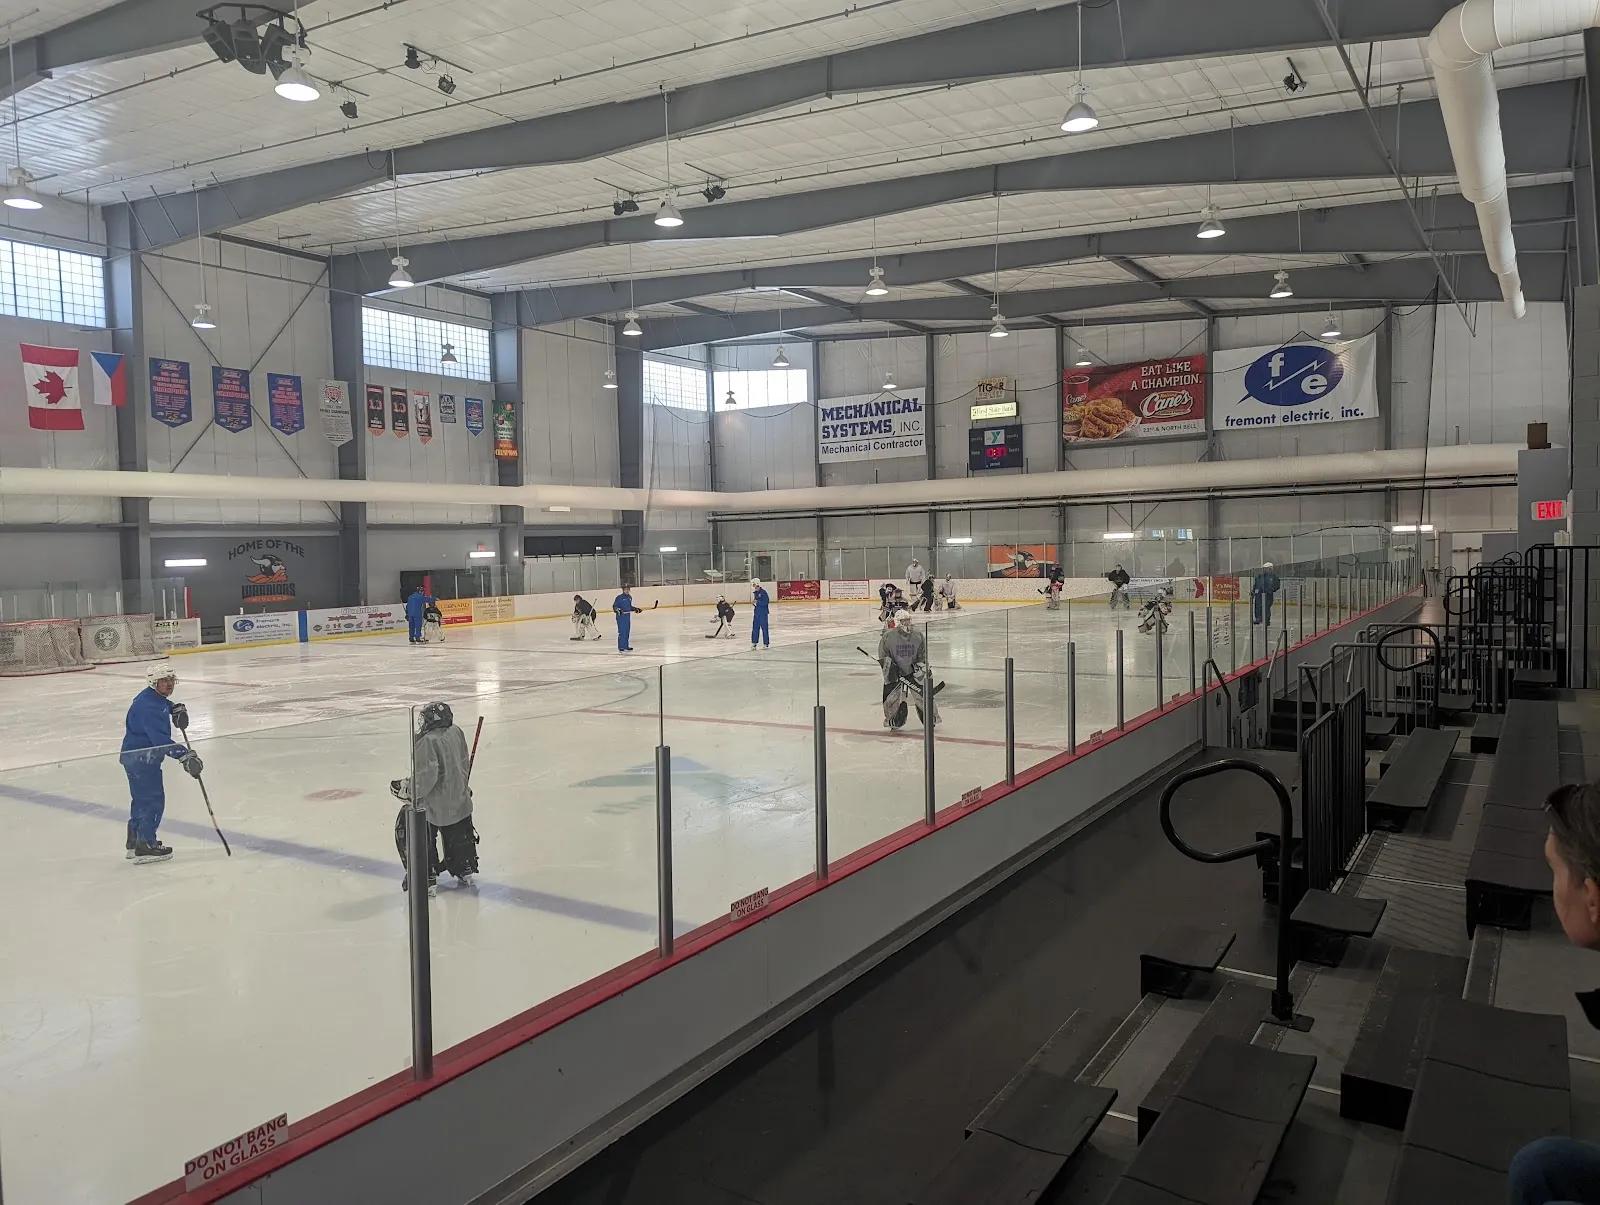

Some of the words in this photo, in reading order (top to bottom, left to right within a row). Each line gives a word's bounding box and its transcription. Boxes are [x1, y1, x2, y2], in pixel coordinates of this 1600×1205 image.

[1141, 365, 1163, 377] EAT
[1166, 361, 1191, 374] LIKE
[1268, 353, 1284, 377] f
[1130, 381, 1139, 391] A
[1141, 374, 1202, 391] CHAMPION.
[1301, 374, 1328, 395] e
[821, 397, 923, 422] MECHANICAL
[1141, 390, 1192, 418] Cane's
[1225, 414, 1276, 427] fremont
[1282, 409, 1334, 422] electric,
[1341, 406, 1364, 418] inc.
[822, 418, 896, 440] SYSTEMS,
[900, 420, 923, 433] INC.
[1161, 424, 1182, 432] NORTH
[821, 443, 871, 455] Mechanical
[873, 439, 924, 451] Contractor
[1537, 501, 1563, 519] EXIT
[228, 540, 263, 561] HOME
[265, 539, 282, 549] OF
[283, 541, 305, 558] THE
[241, 583, 296, 600] WARRIORS
[731, 902, 740, 912] DO
[740, 896, 753, 907] NOT
[753, 889, 769, 901] BANG
[737, 907, 746, 918] ON
[747, 899, 764, 913] GLASS
[185, 1155, 208, 1176] DO
[212, 1136, 243, 1161] NOT
[246, 1115, 287, 1144] BANG
[203, 1160, 226, 1180] ON
[230, 1135, 276, 1166] GLASS
